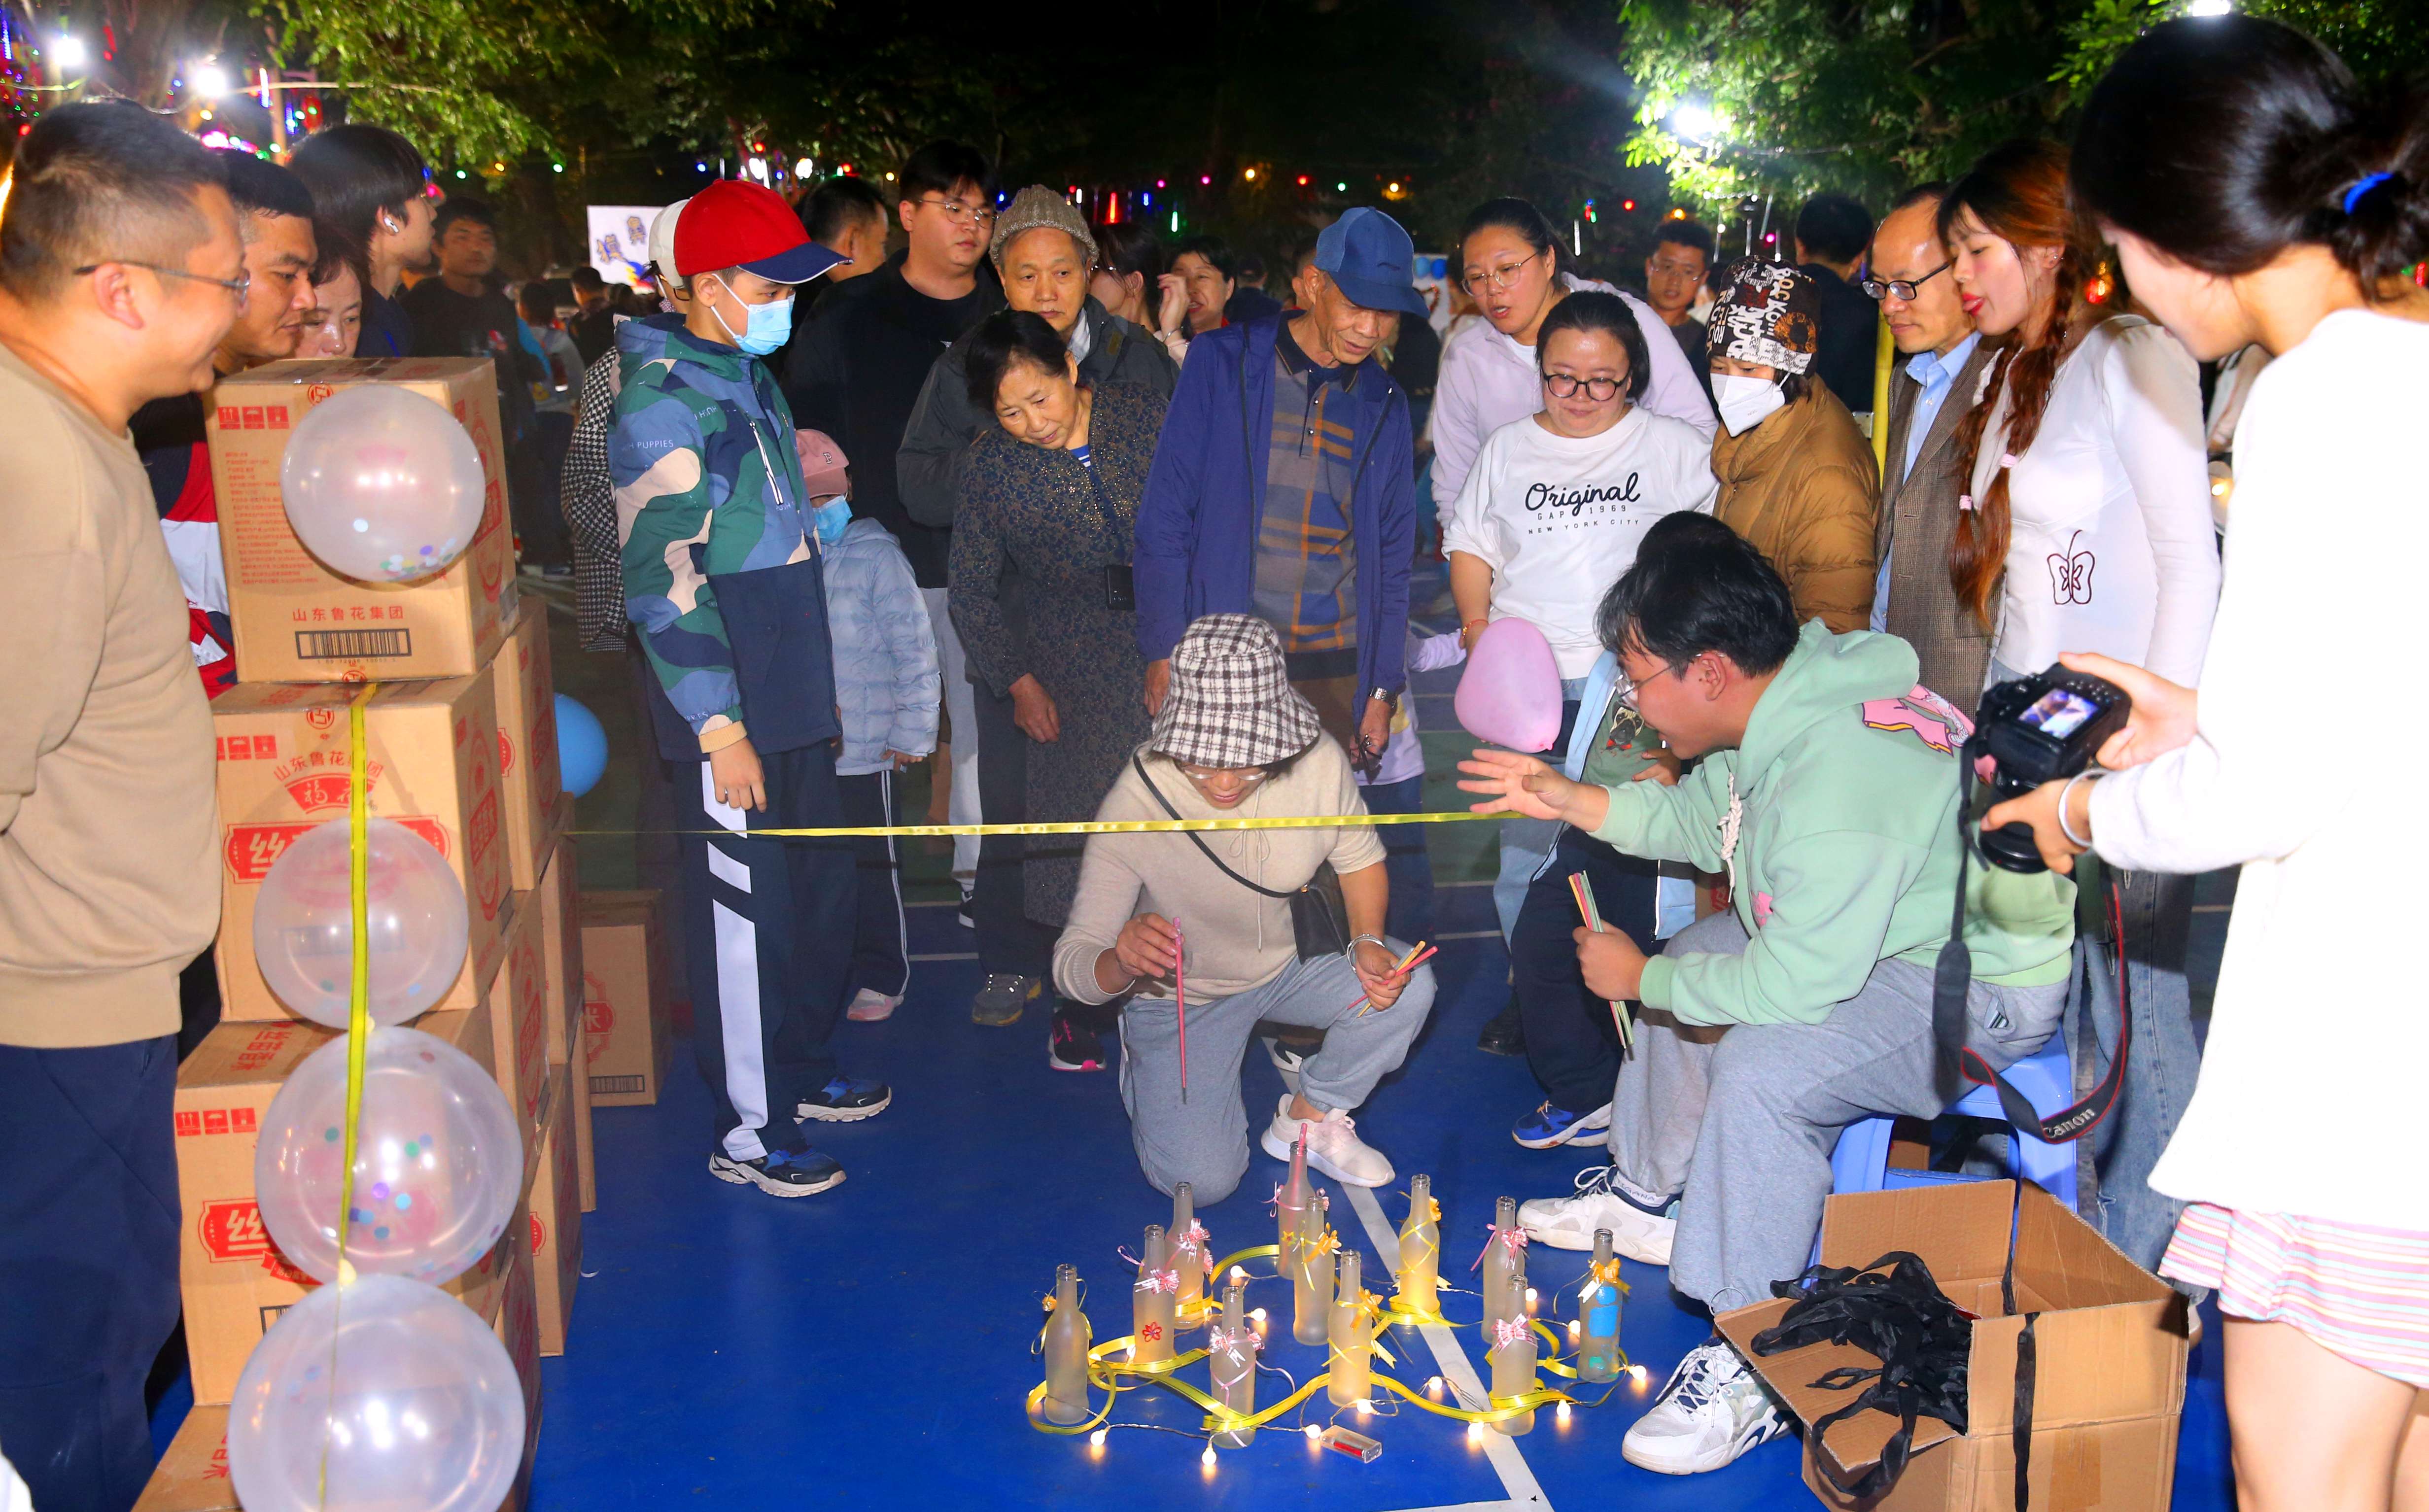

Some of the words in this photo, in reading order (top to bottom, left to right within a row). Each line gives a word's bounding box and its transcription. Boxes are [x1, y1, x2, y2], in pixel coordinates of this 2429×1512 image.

[637, 439, 674, 449] PUPPIES
[823, 452, 833, 464] P
[1525, 472, 1641, 516] Original
[1537, 511, 1564, 520] GAP
[1589, 505, 1626, 514] 1969
[1528, 526, 1553, 535] NEW
[1564, 520, 1598, 530] YORK
[292, 606, 404, 621] 山东鲁花集团
[273, 751, 383, 782] 山东鲁花团
[2043, 1108, 2095, 1138] Canon
